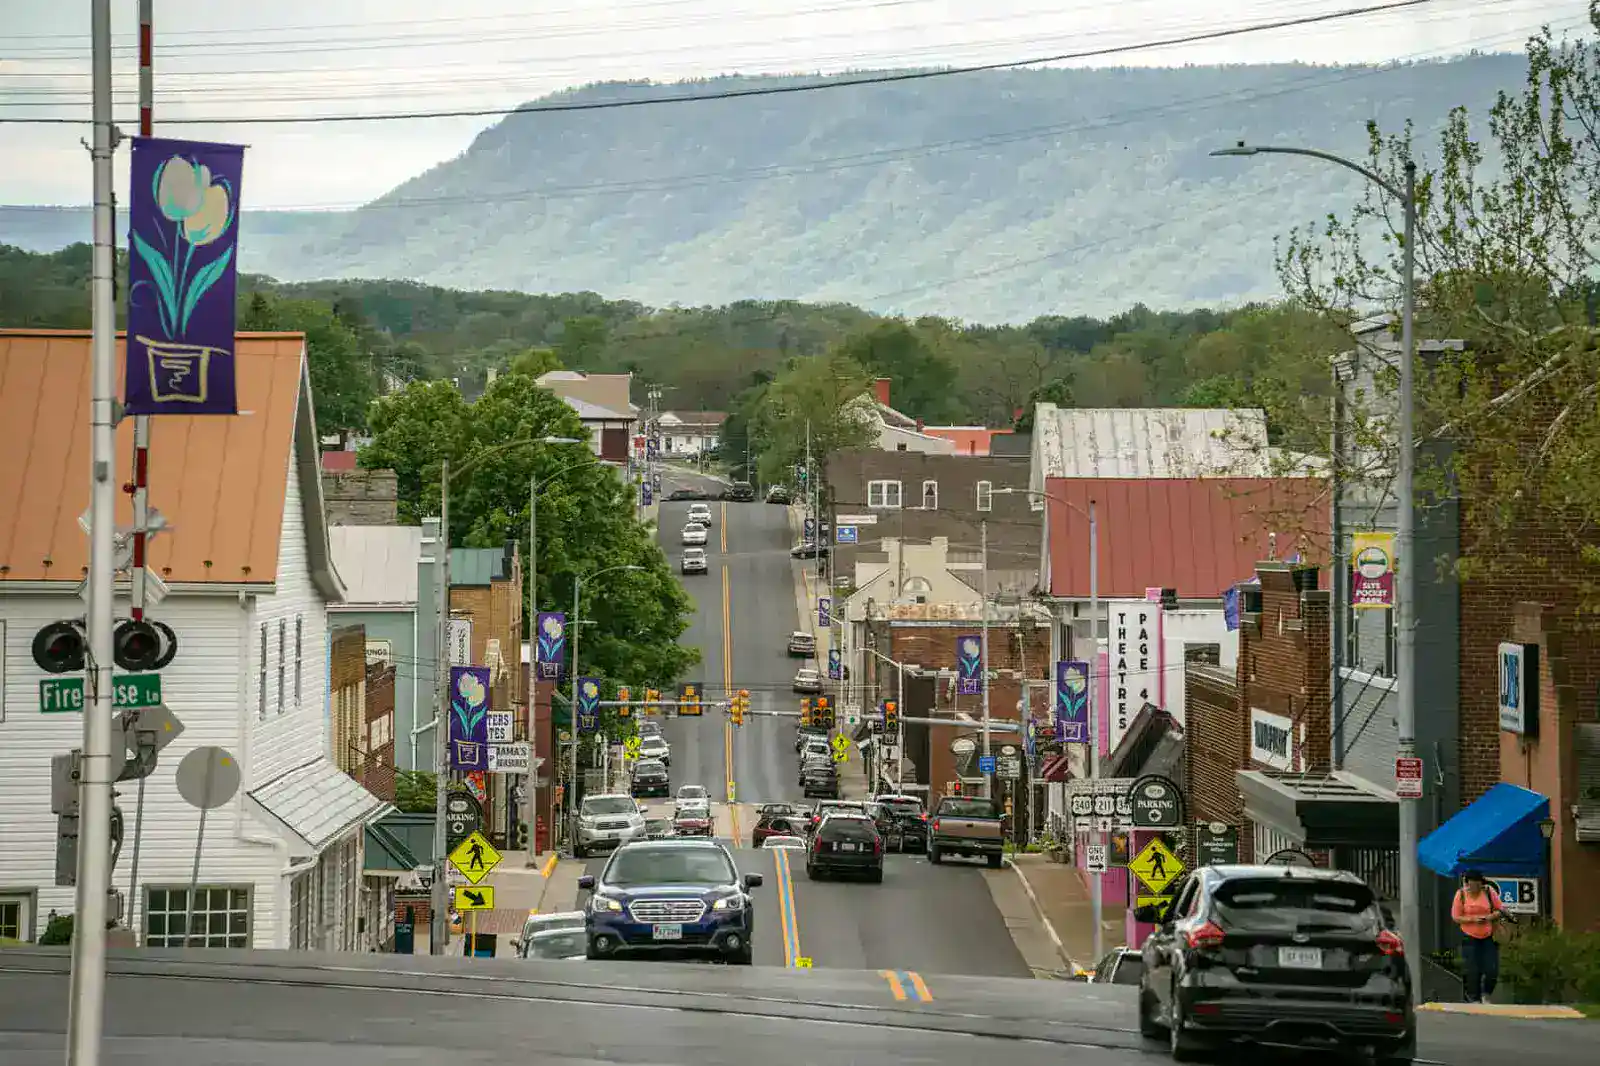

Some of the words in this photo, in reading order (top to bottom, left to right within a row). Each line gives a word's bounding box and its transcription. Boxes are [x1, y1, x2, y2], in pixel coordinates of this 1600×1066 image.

[1139, 613, 1148, 670] PAGE
[1118, 613, 1127, 729] THEATRES
[42, 682, 138, 709] Firese
[146, 689, 159, 702] Ln
[1139, 688, 1148, 699] 4
[1098, 800, 1111, 812] 211
[1137, 800, 1173, 809] PARKING
[446, 813, 475, 821] ARKING
[1089, 854, 1104, 862] WAY
[1519, 881, 1535, 903] B
